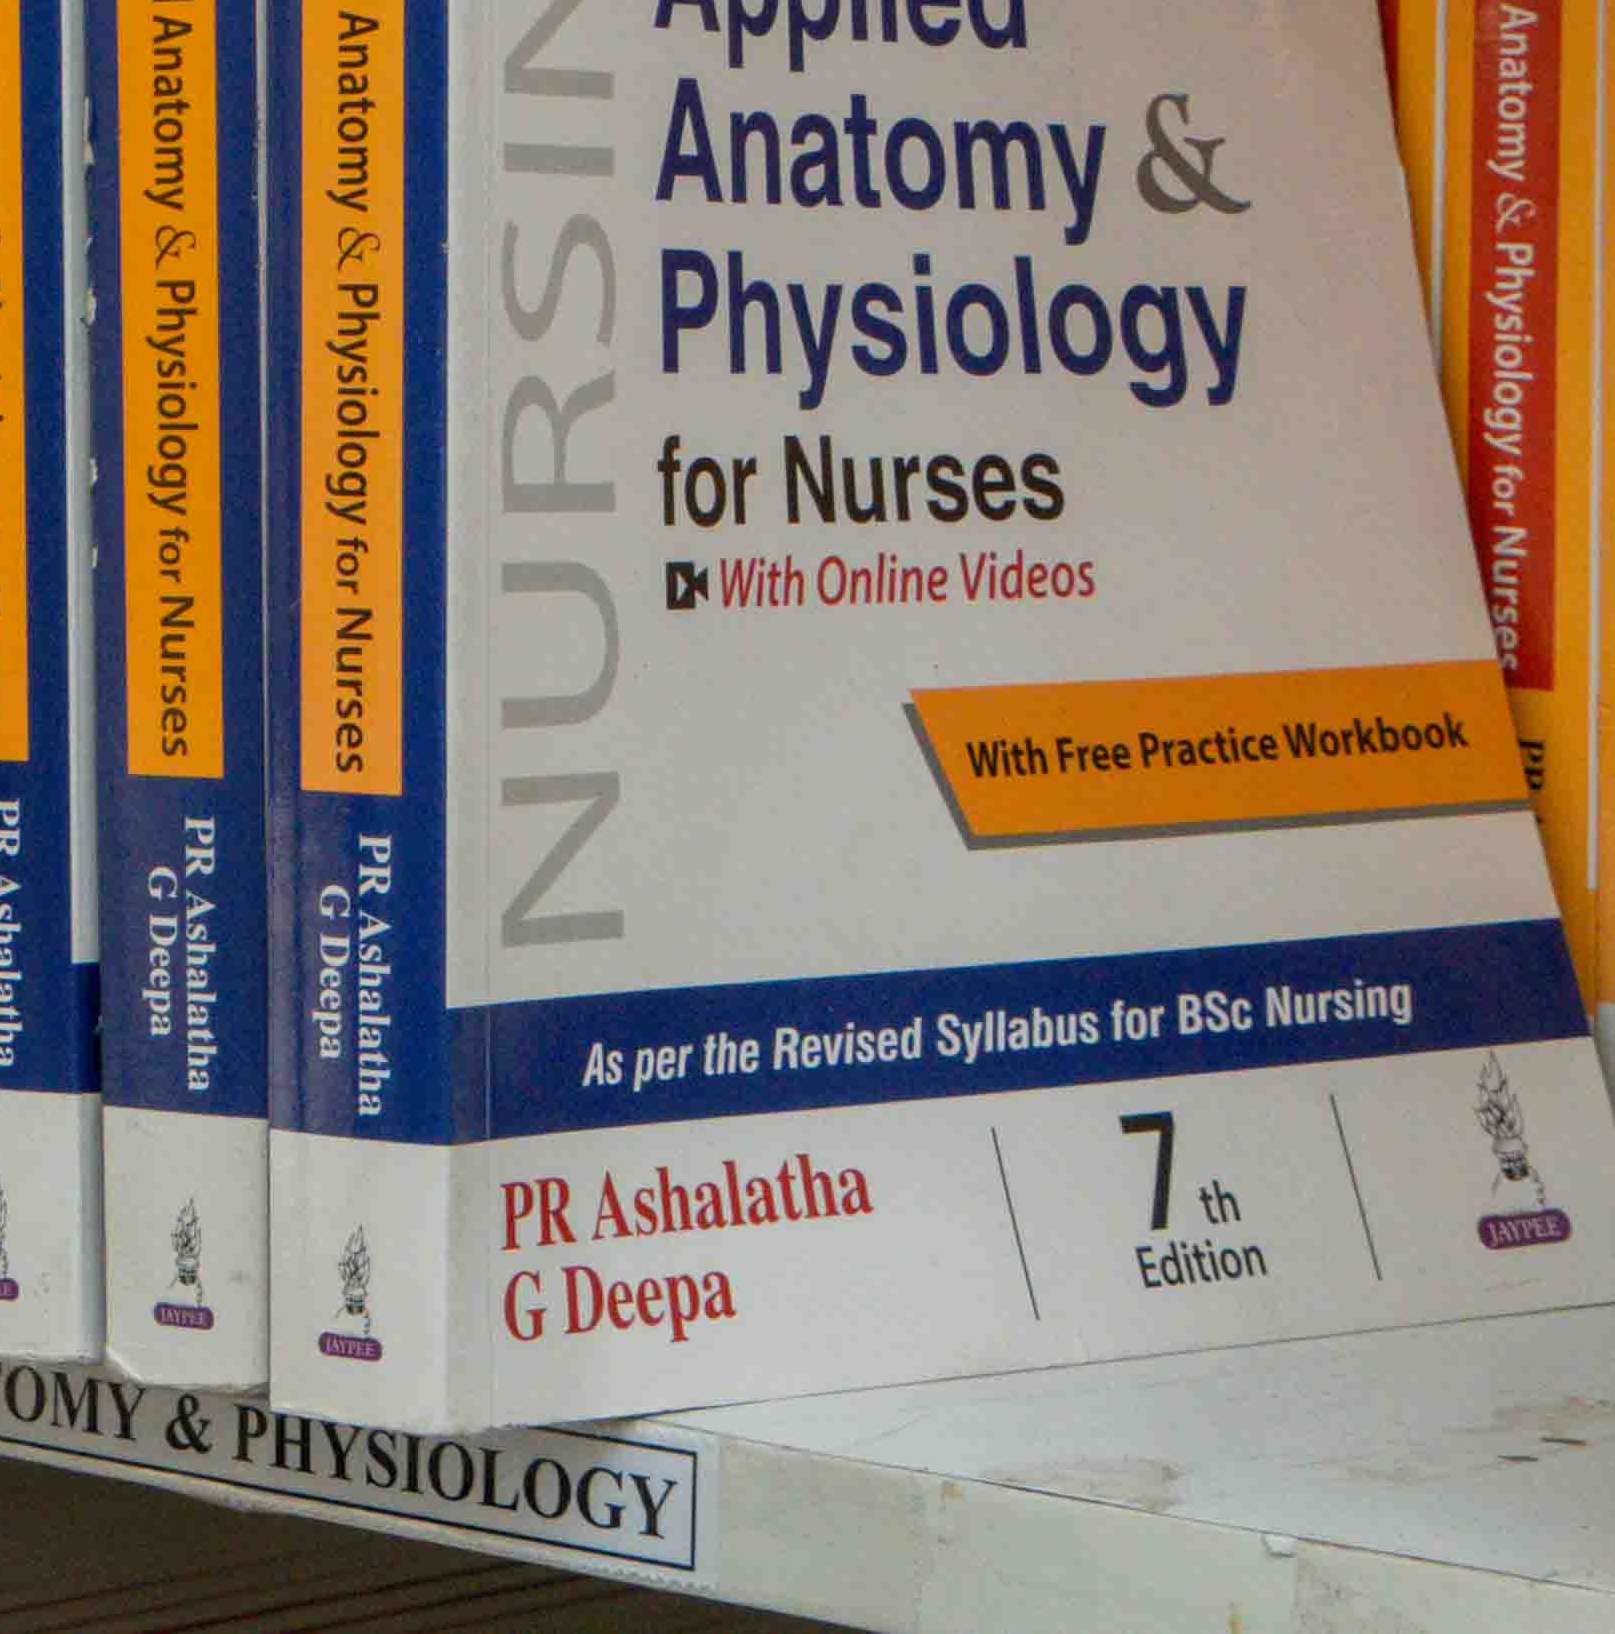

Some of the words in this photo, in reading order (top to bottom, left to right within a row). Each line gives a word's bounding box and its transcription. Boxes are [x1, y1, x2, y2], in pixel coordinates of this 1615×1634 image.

[143, 16, 193, 210] Anatomy
[326, 12, 379, 211] Anatomy
[1487, 5, 1539, 181] Anatomy
[655, 76, 1107, 247] Anatomy
[1135, 92, 1252, 216] &
[154, 225, 196, 267] &
[337, 228, 381, 271] &
[1496, 193, 1536, 232] &
[659, 246, 1247, 410] Physiology
[1484, 242, 1536, 455] Physiology
[145, 280, 199, 515] Physiology
[325, 284, 381, 524] Physiology
[657, 434, 759, 528] for
[783, 434, 1066, 526] Nurses
[1493, 465, 1524, 516] for
[159, 527, 190, 583] for
[336, 537, 368, 593] for
[719, 554, 805, 609] With
[816, 554, 949, 609] Online
[957, 550, 1097, 604] Videos
[160, 595, 195, 756] Nurses
[335, 608, 372, 772] Nurses
[966, 736, 1047, 783] With
[1054, 731, 1132, 775] Free
[1138, 722, 1279, 771] Practice
[1282, 709, 1470, 759] Workbook
[147, 866, 177, 900] G
[184, 817, 216, 877] PR
[359, 834, 392, 896] PR
[319, 884, 350, 920] G
[142, 914, 178, 1036] Deepa
[184, 891, 218, 1091] Ashalatha
[313, 933, 351, 1060] Deepa
[358, 910, 392, 1116] Ashalatha
[582, 1040, 622, 1090] As
[632, 1046, 694, 1088] per
[704, 1034, 760, 1077] the
[771, 1019, 923, 1072] Revised
[936, 1006, 1100, 1063] Syllabus
[1110, 998, 1166, 1042] for
[1177, 990, 1254, 1034] BSc
[1264, 978, 1415, 1034] Nursing
[501, 1178, 577, 1253] PR
[589, 1151, 874, 1242] Ashalatha
[1484, 1214, 1566, 1249] JAYPEE
[502, 1269, 547, 1344] G
[562, 1259, 738, 1344] Deepa
[1136, 1238, 1268, 1289] Edition
[323, 1336, 378, 1358] JAYPEE
[165, 1395, 212, 1454] &
[231, 1403, 675, 1539] PHYSIOLOGY
